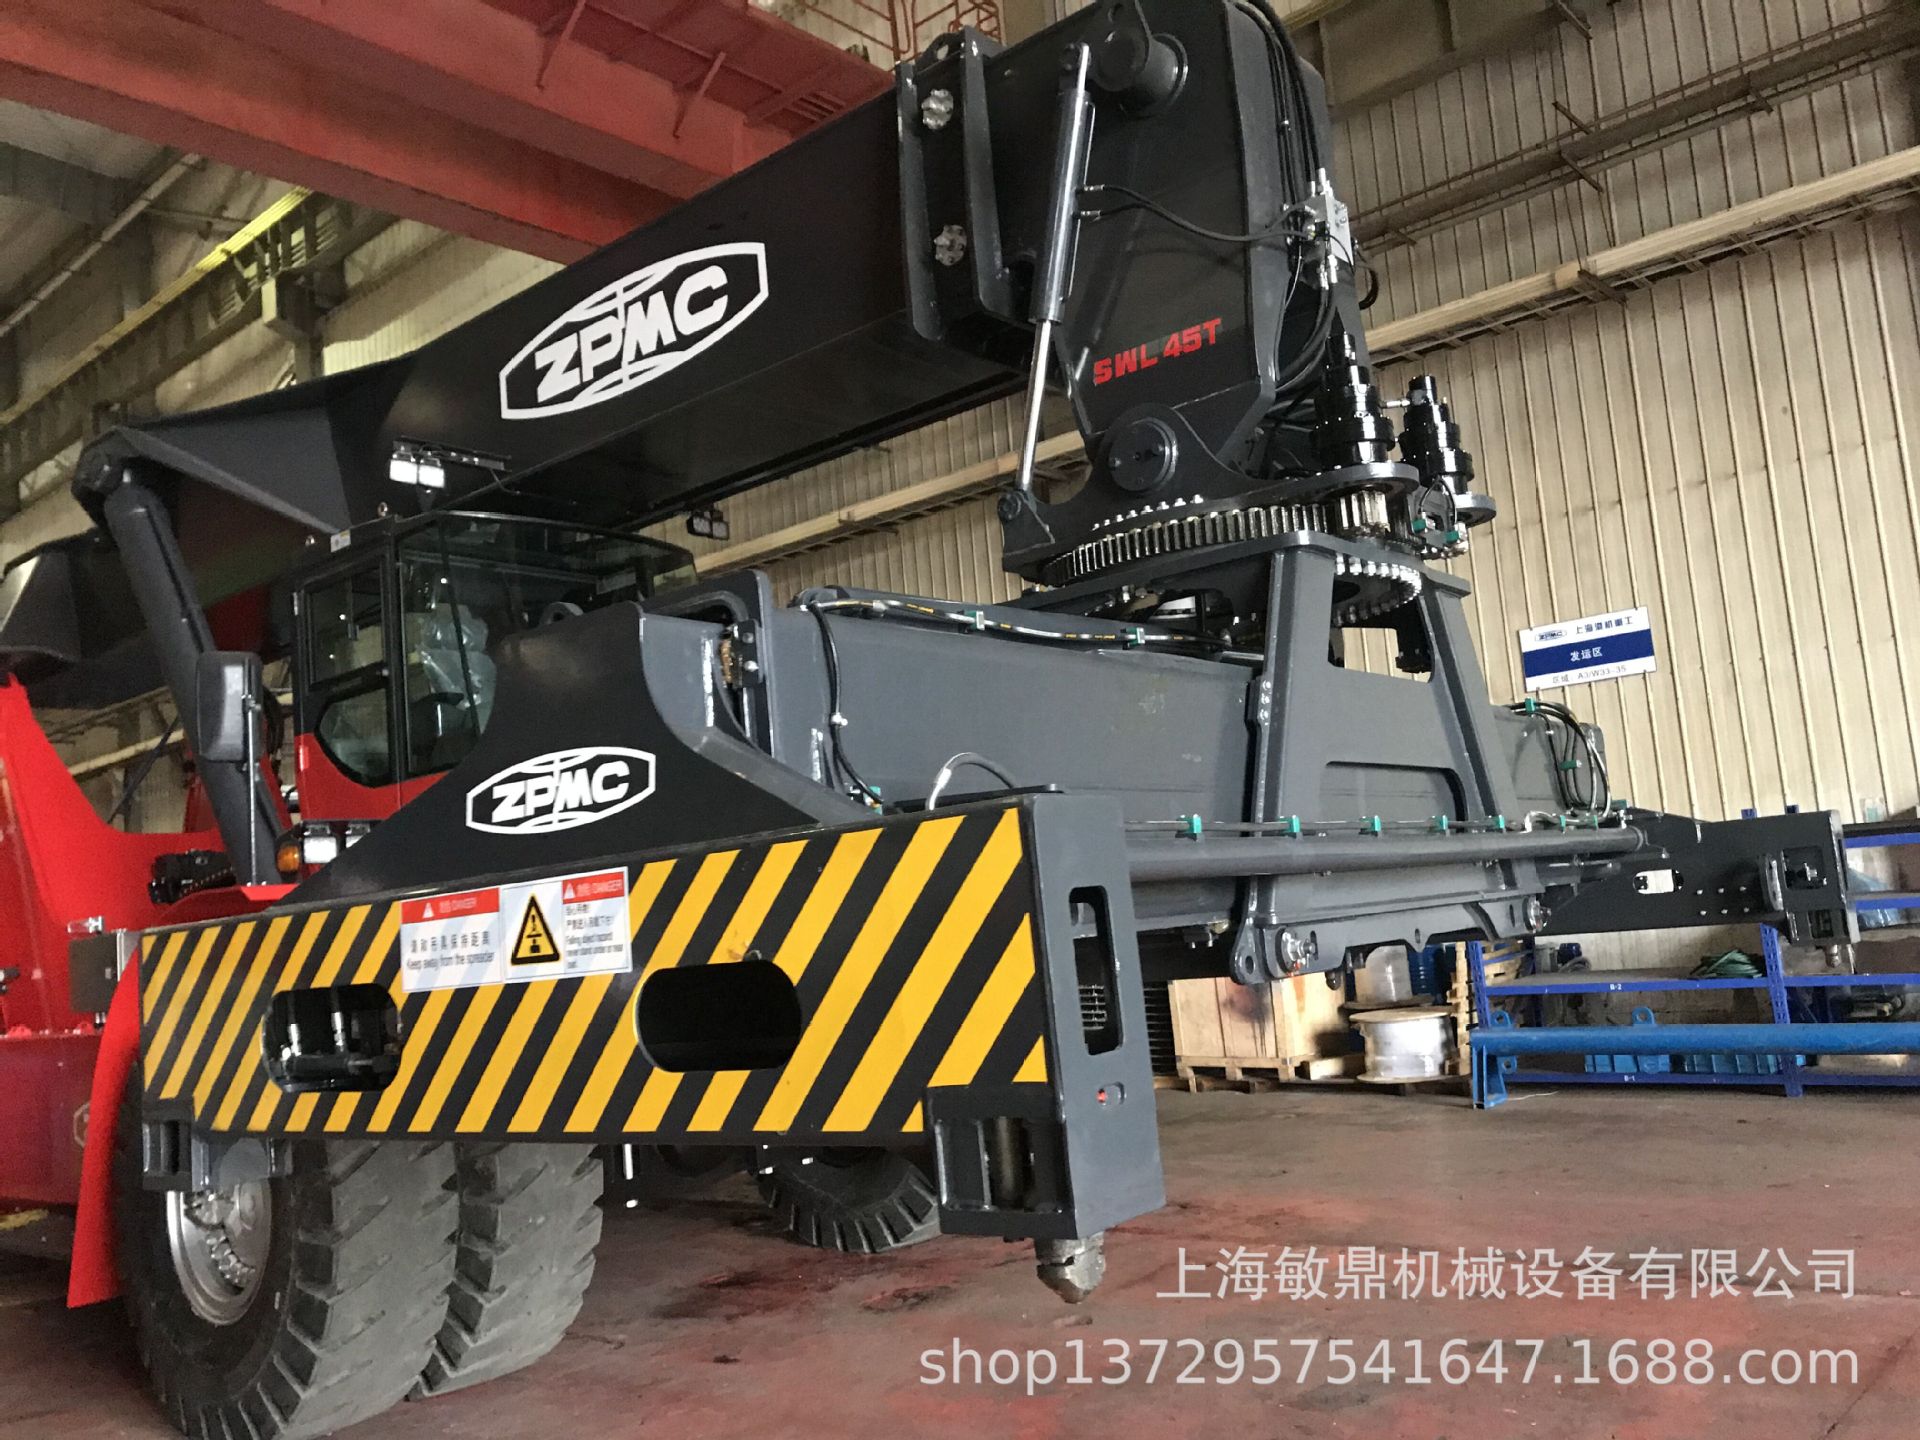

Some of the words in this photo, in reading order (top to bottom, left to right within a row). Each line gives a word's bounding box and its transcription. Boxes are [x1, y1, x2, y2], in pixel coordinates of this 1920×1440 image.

[535, 265, 728, 403] ZPMC
[1093, 343, 1158, 385] SWL
[1163, 317, 1222, 358] 45T
[1570, 647, 1603, 662] 发运区
[491, 760, 630, 823] ZPMC
